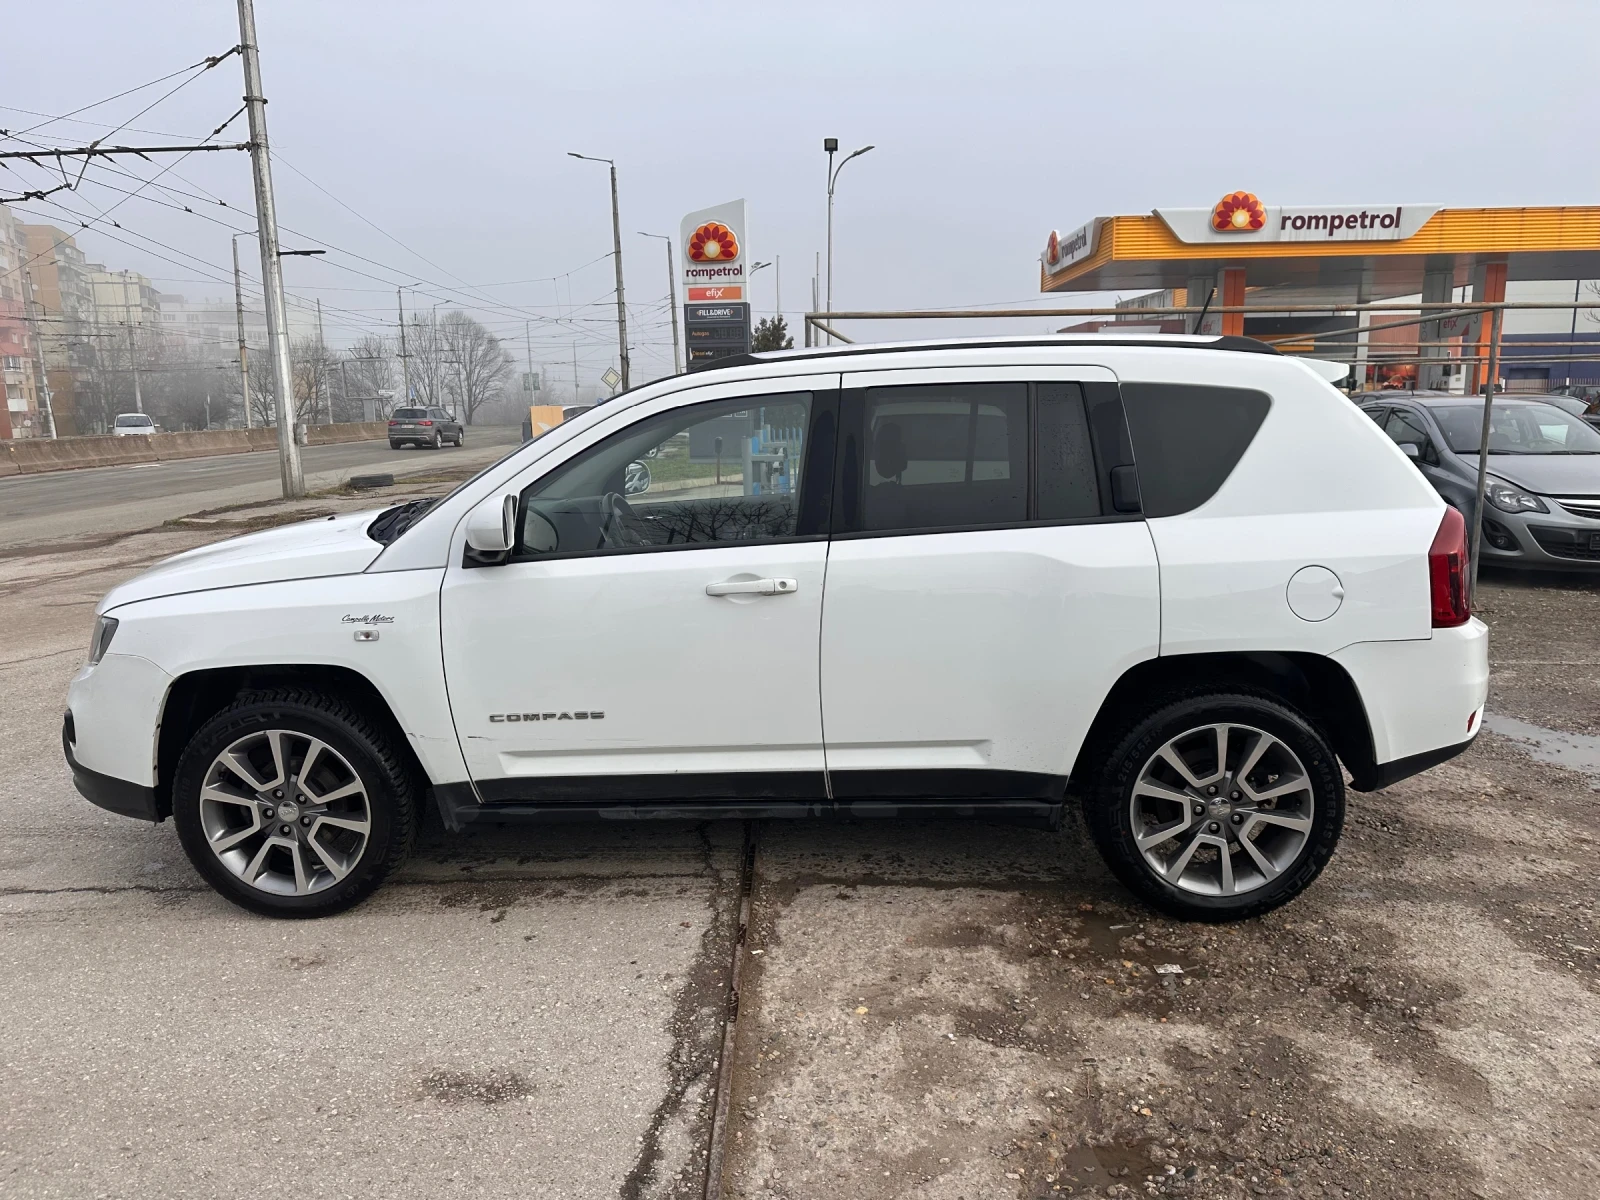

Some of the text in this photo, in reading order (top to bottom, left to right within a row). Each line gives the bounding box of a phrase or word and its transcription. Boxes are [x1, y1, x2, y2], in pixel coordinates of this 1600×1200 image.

[1280, 206, 1402, 236] rompetrol
[1060, 226, 1088, 260] rompetrol
[685, 264, 743, 280] rompetrol
[705, 288, 724, 299] efix
[699, 308, 731, 316] FILL&DRIVE
[489, 710, 605, 723] COMPASS
[1317, 758, 1336, 819] MASTER
